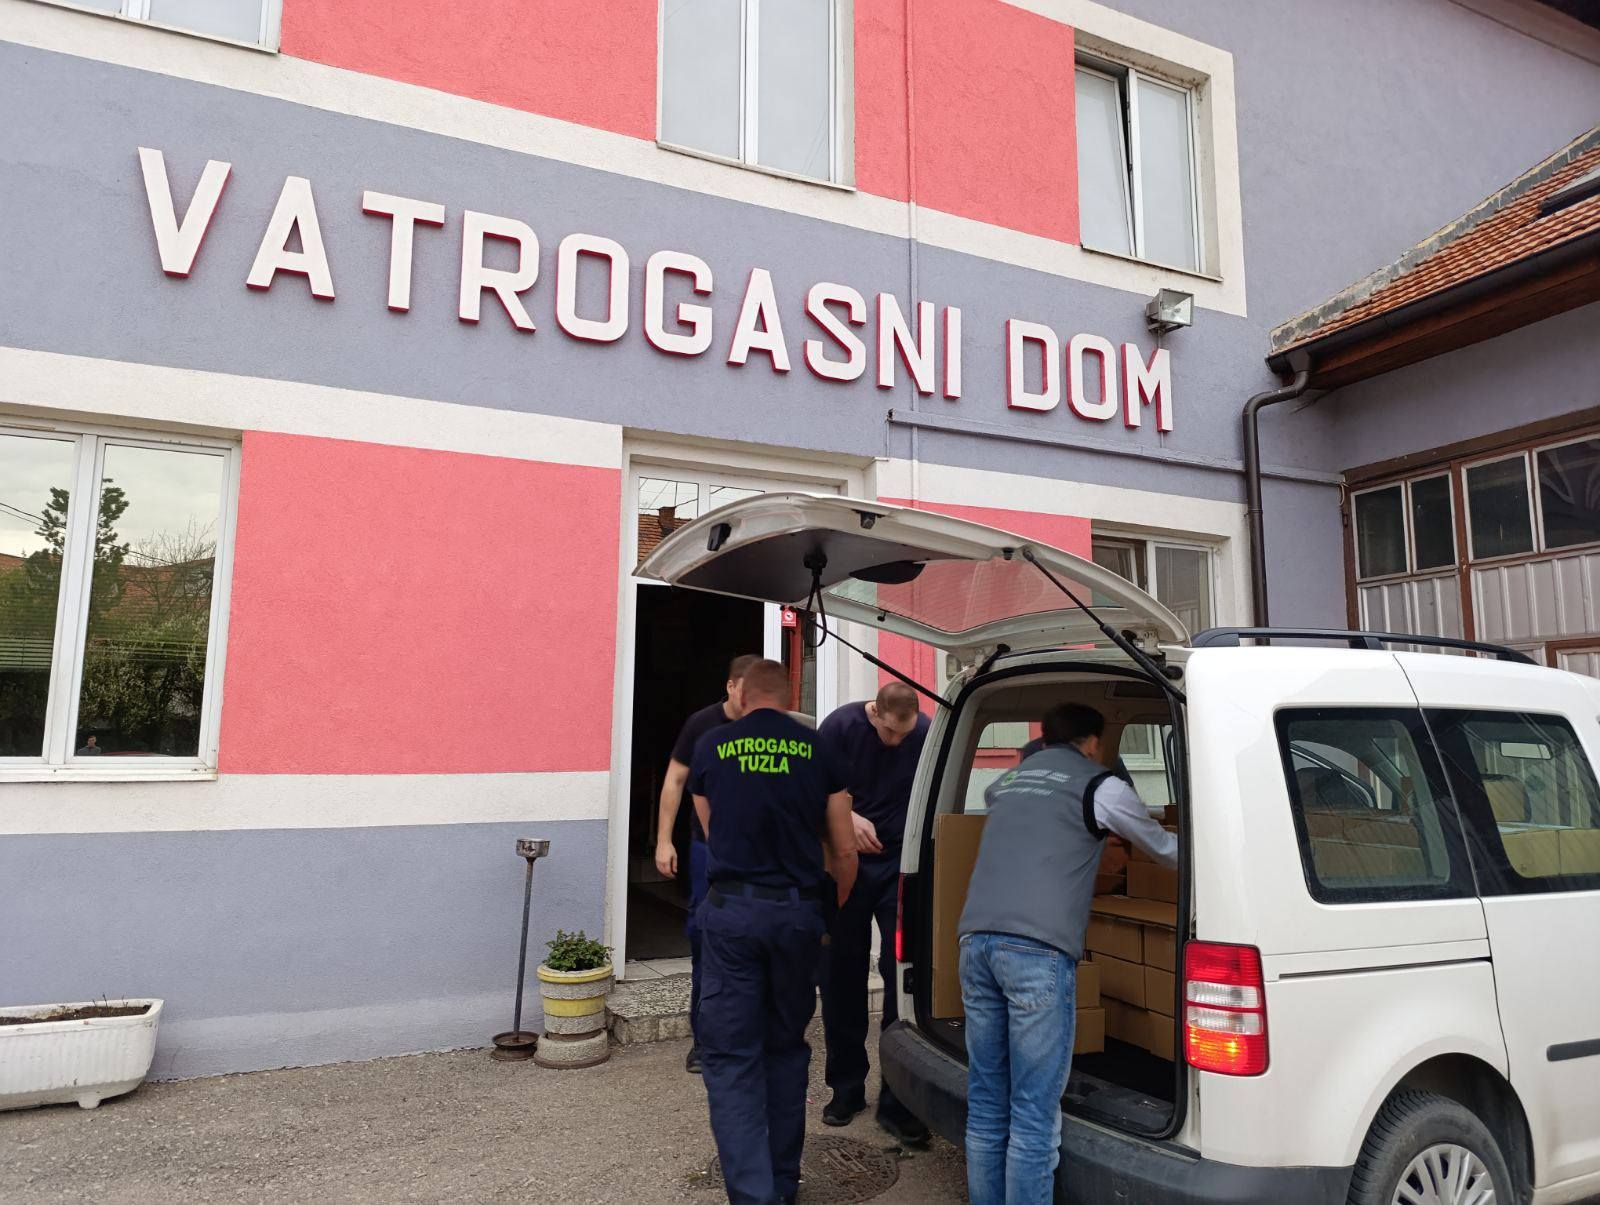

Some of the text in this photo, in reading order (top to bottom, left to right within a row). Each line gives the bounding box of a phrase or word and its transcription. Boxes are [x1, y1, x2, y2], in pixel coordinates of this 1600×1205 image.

[137, 146, 1175, 433] VATROGASNI DOM
[716, 737, 813, 760] VATROGASCI
[738, 755, 790, 774] TUZLA
